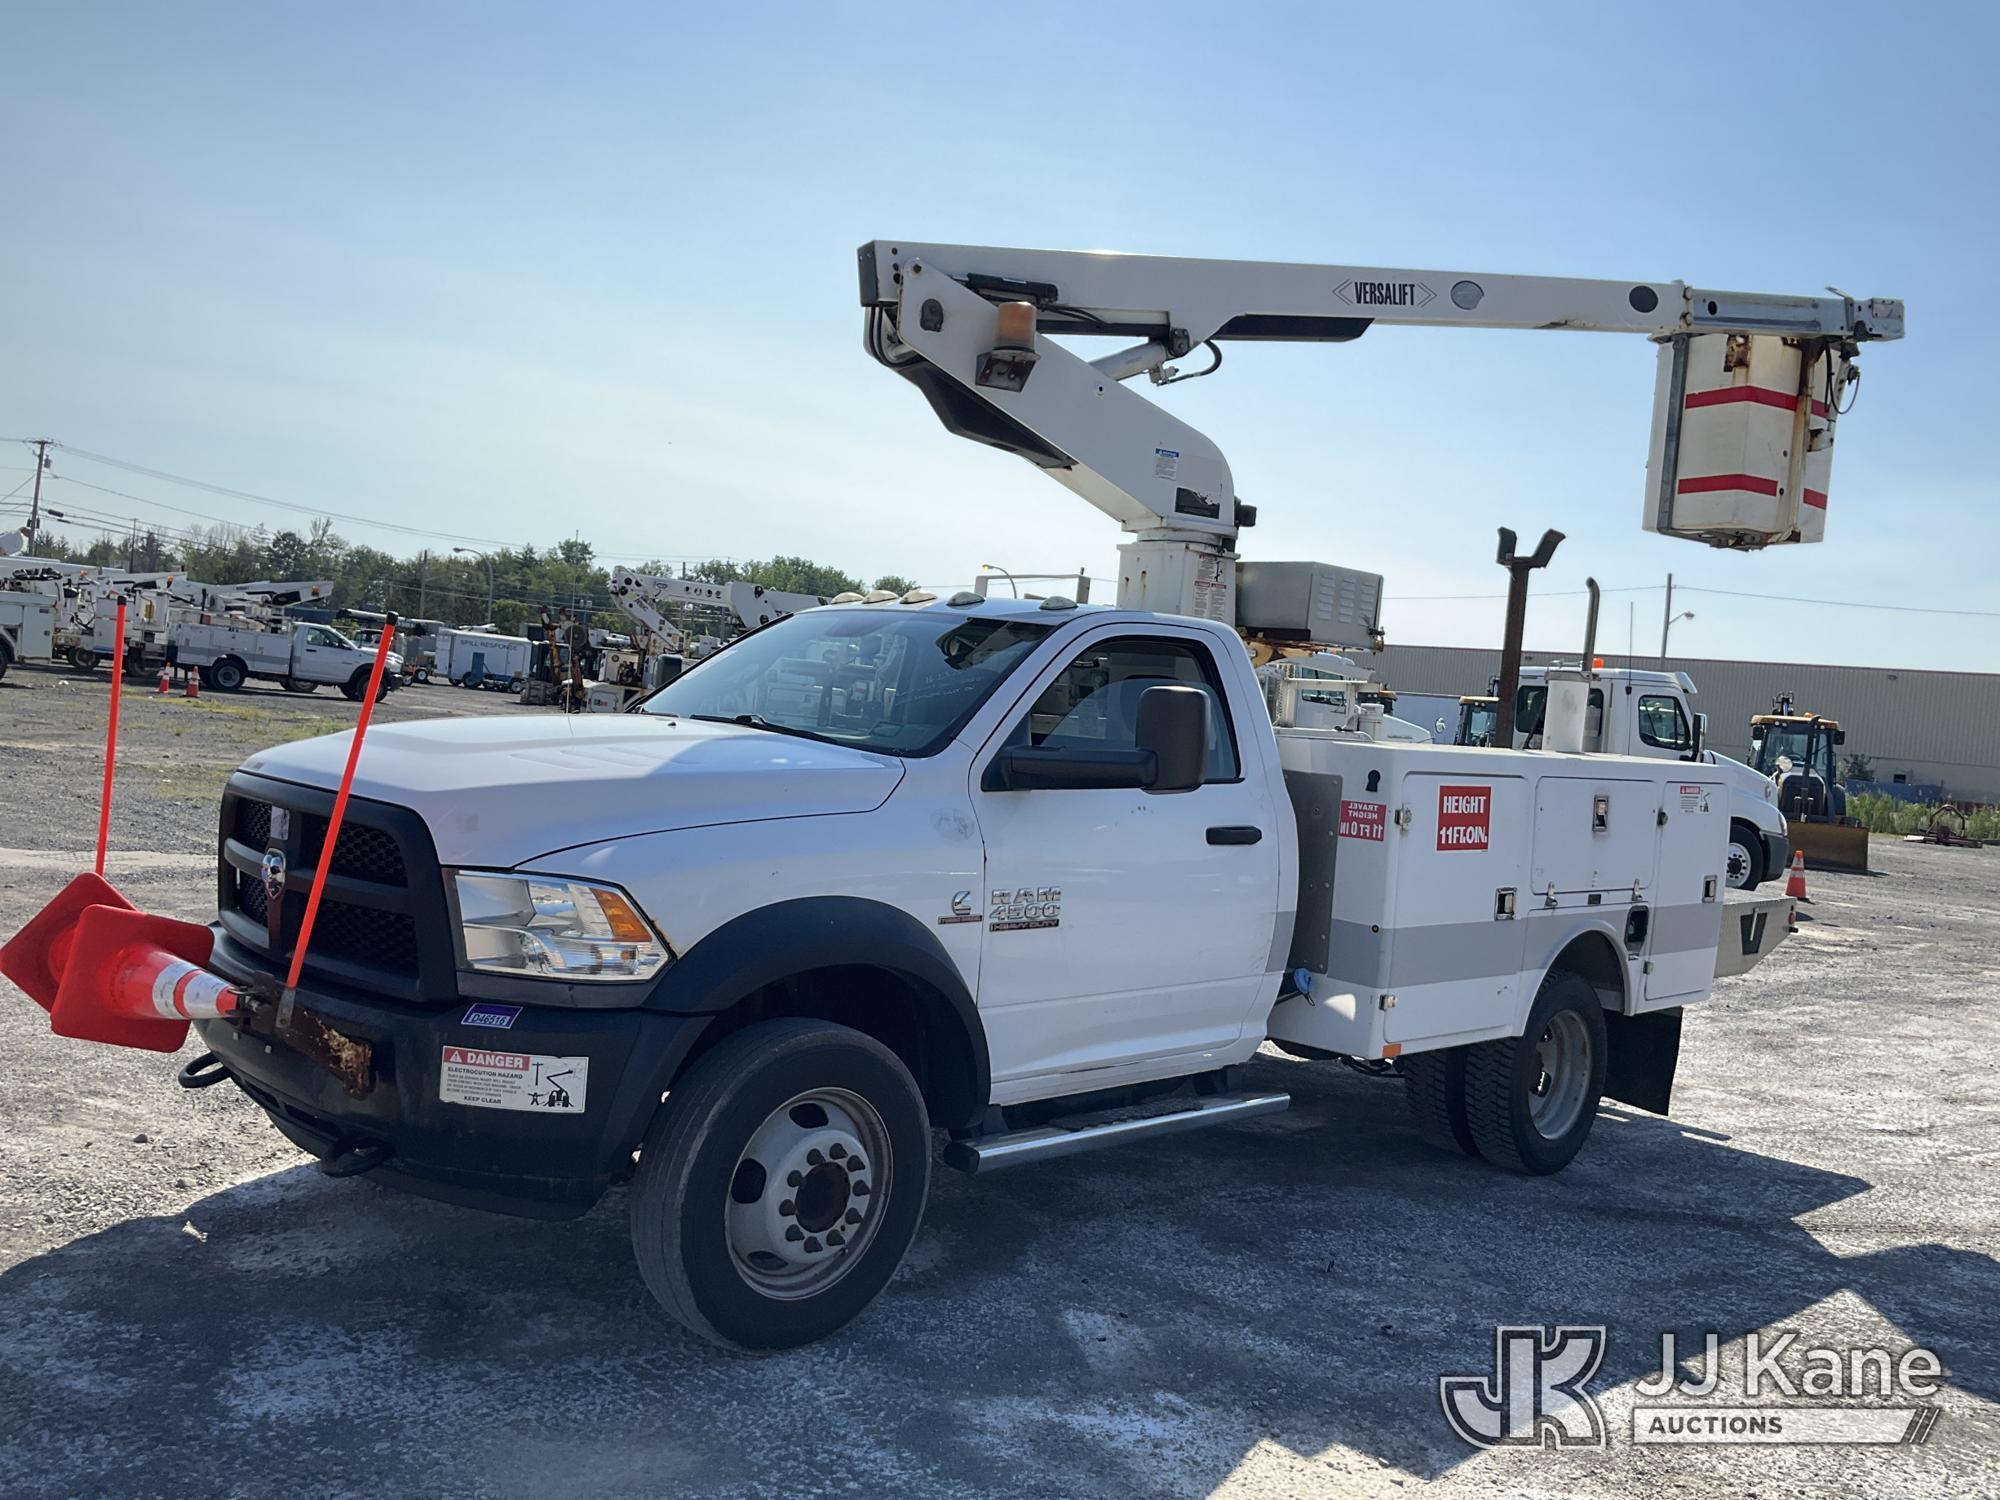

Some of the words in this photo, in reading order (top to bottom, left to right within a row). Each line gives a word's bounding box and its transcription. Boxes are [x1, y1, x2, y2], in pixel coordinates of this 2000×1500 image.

[1354, 281, 1416, 306] VERSALIFT
[1443, 795, 1487, 814] HEIGHT
[991, 886, 1061, 905] RAM
[990, 902, 1060, 920] 4500
[1030, 919, 1058, 929] DUTY
[466, 1052, 524, 1069] DANGER
[447, 1066, 497, 1077] ELECTROCUTION
[497, 1071, 523, 1080] HAZARD
[481, 1097, 502, 1105] CLEAR
